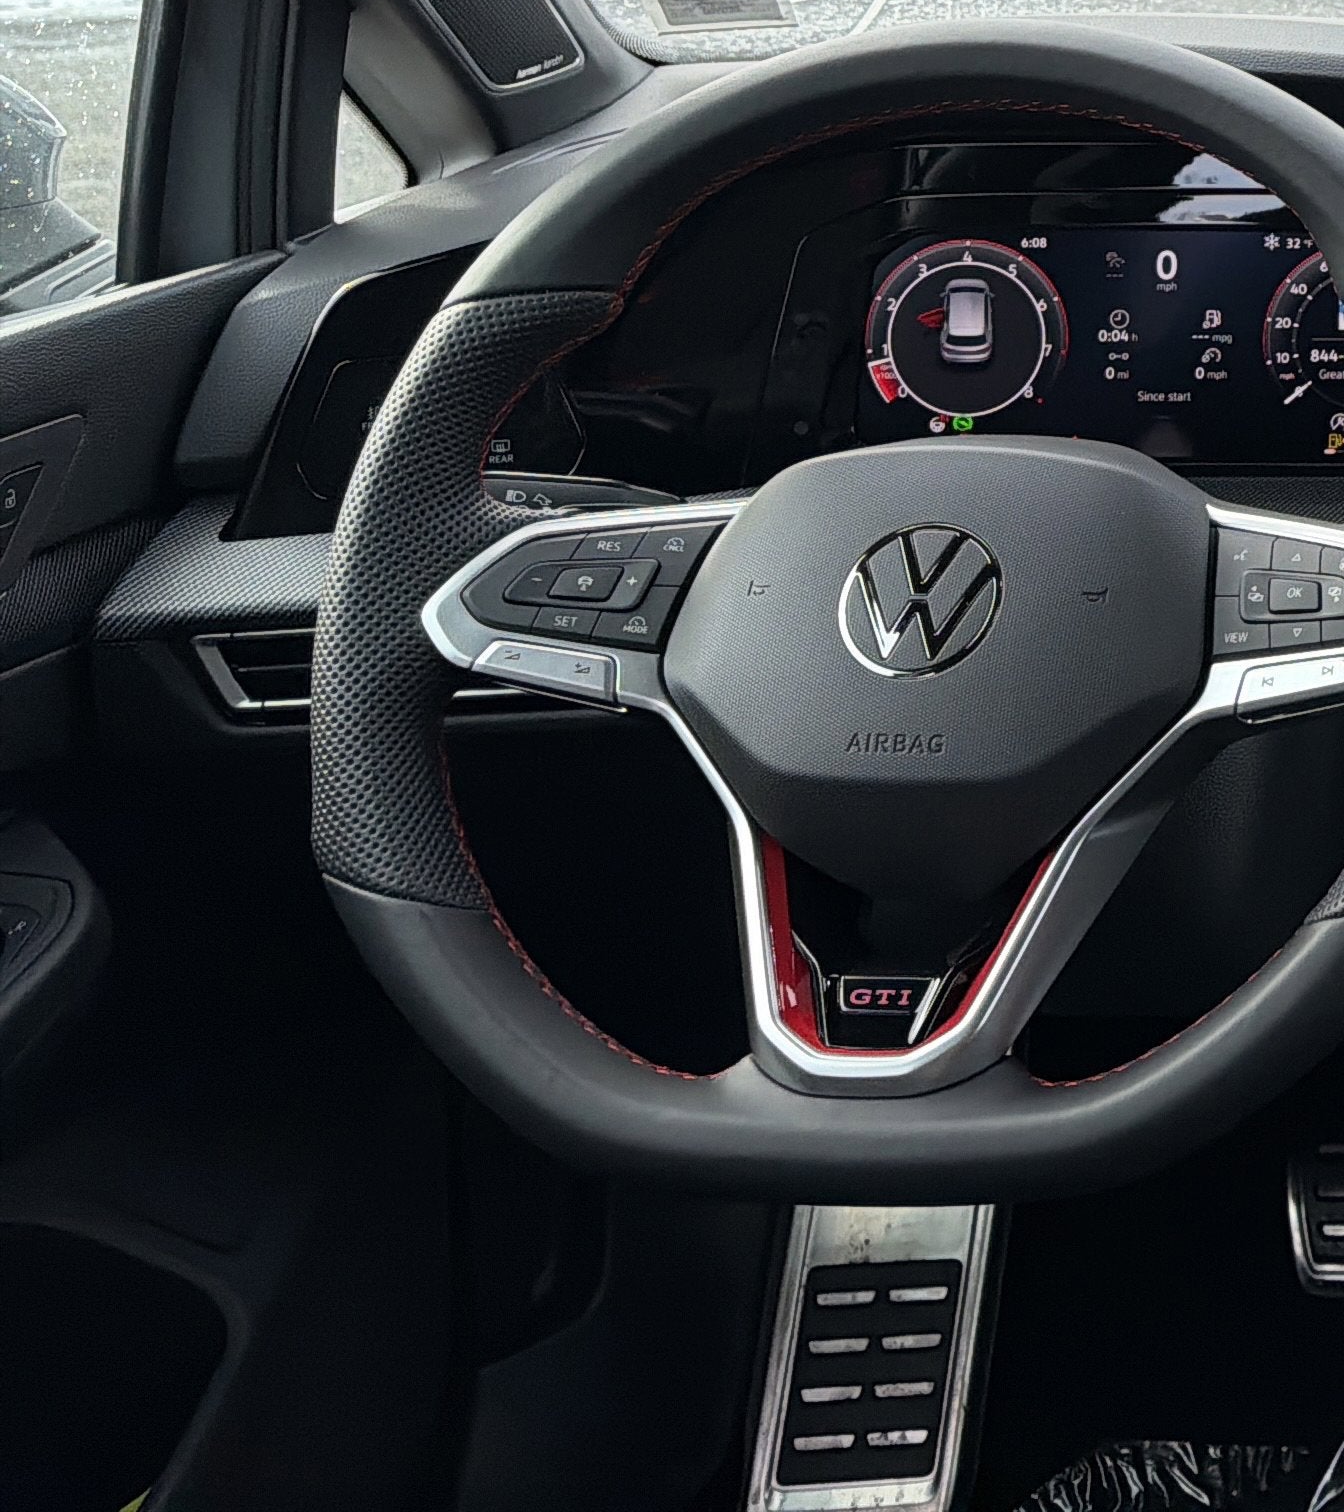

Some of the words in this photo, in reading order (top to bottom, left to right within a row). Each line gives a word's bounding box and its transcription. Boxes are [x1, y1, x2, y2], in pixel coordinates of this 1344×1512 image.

[1021, 237, 1047, 248] 6:08
[1286, 238, 1301, 249] 32
[1156, 250, 1178, 280] 0
[1156, 282, 1178, 292] mph
[1289, 283, 1308, 295] 40
[1275, 317, 1292, 328] 20
[1098, 329, 1129, 342] 0:04
[1132, 330, 1139, 342] h
[1212, 333, 1233, 344] mpg
[1276, 352, 1290, 364] 10
[1105, 367, 1115, 380] 0
[1117, 369, 1129, 379] mi
[1195, 367, 1205, 380] 0
[1207, 369, 1228, 380] mph
[1137, 390, 1165, 402] Since
[1168, 391, 1191, 402] start
[488, 455, 514, 464] REAR
[597, 540, 621, 552] RES
[1286, 588, 1303, 599] OK
[553, 616, 578, 628] SET
[622, 624, 649, 634] MODE
[1224, 632, 1249, 644] VIEW
[844, 730, 947, 756] AIRBAG
[848, 986, 914, 1008] GTI
